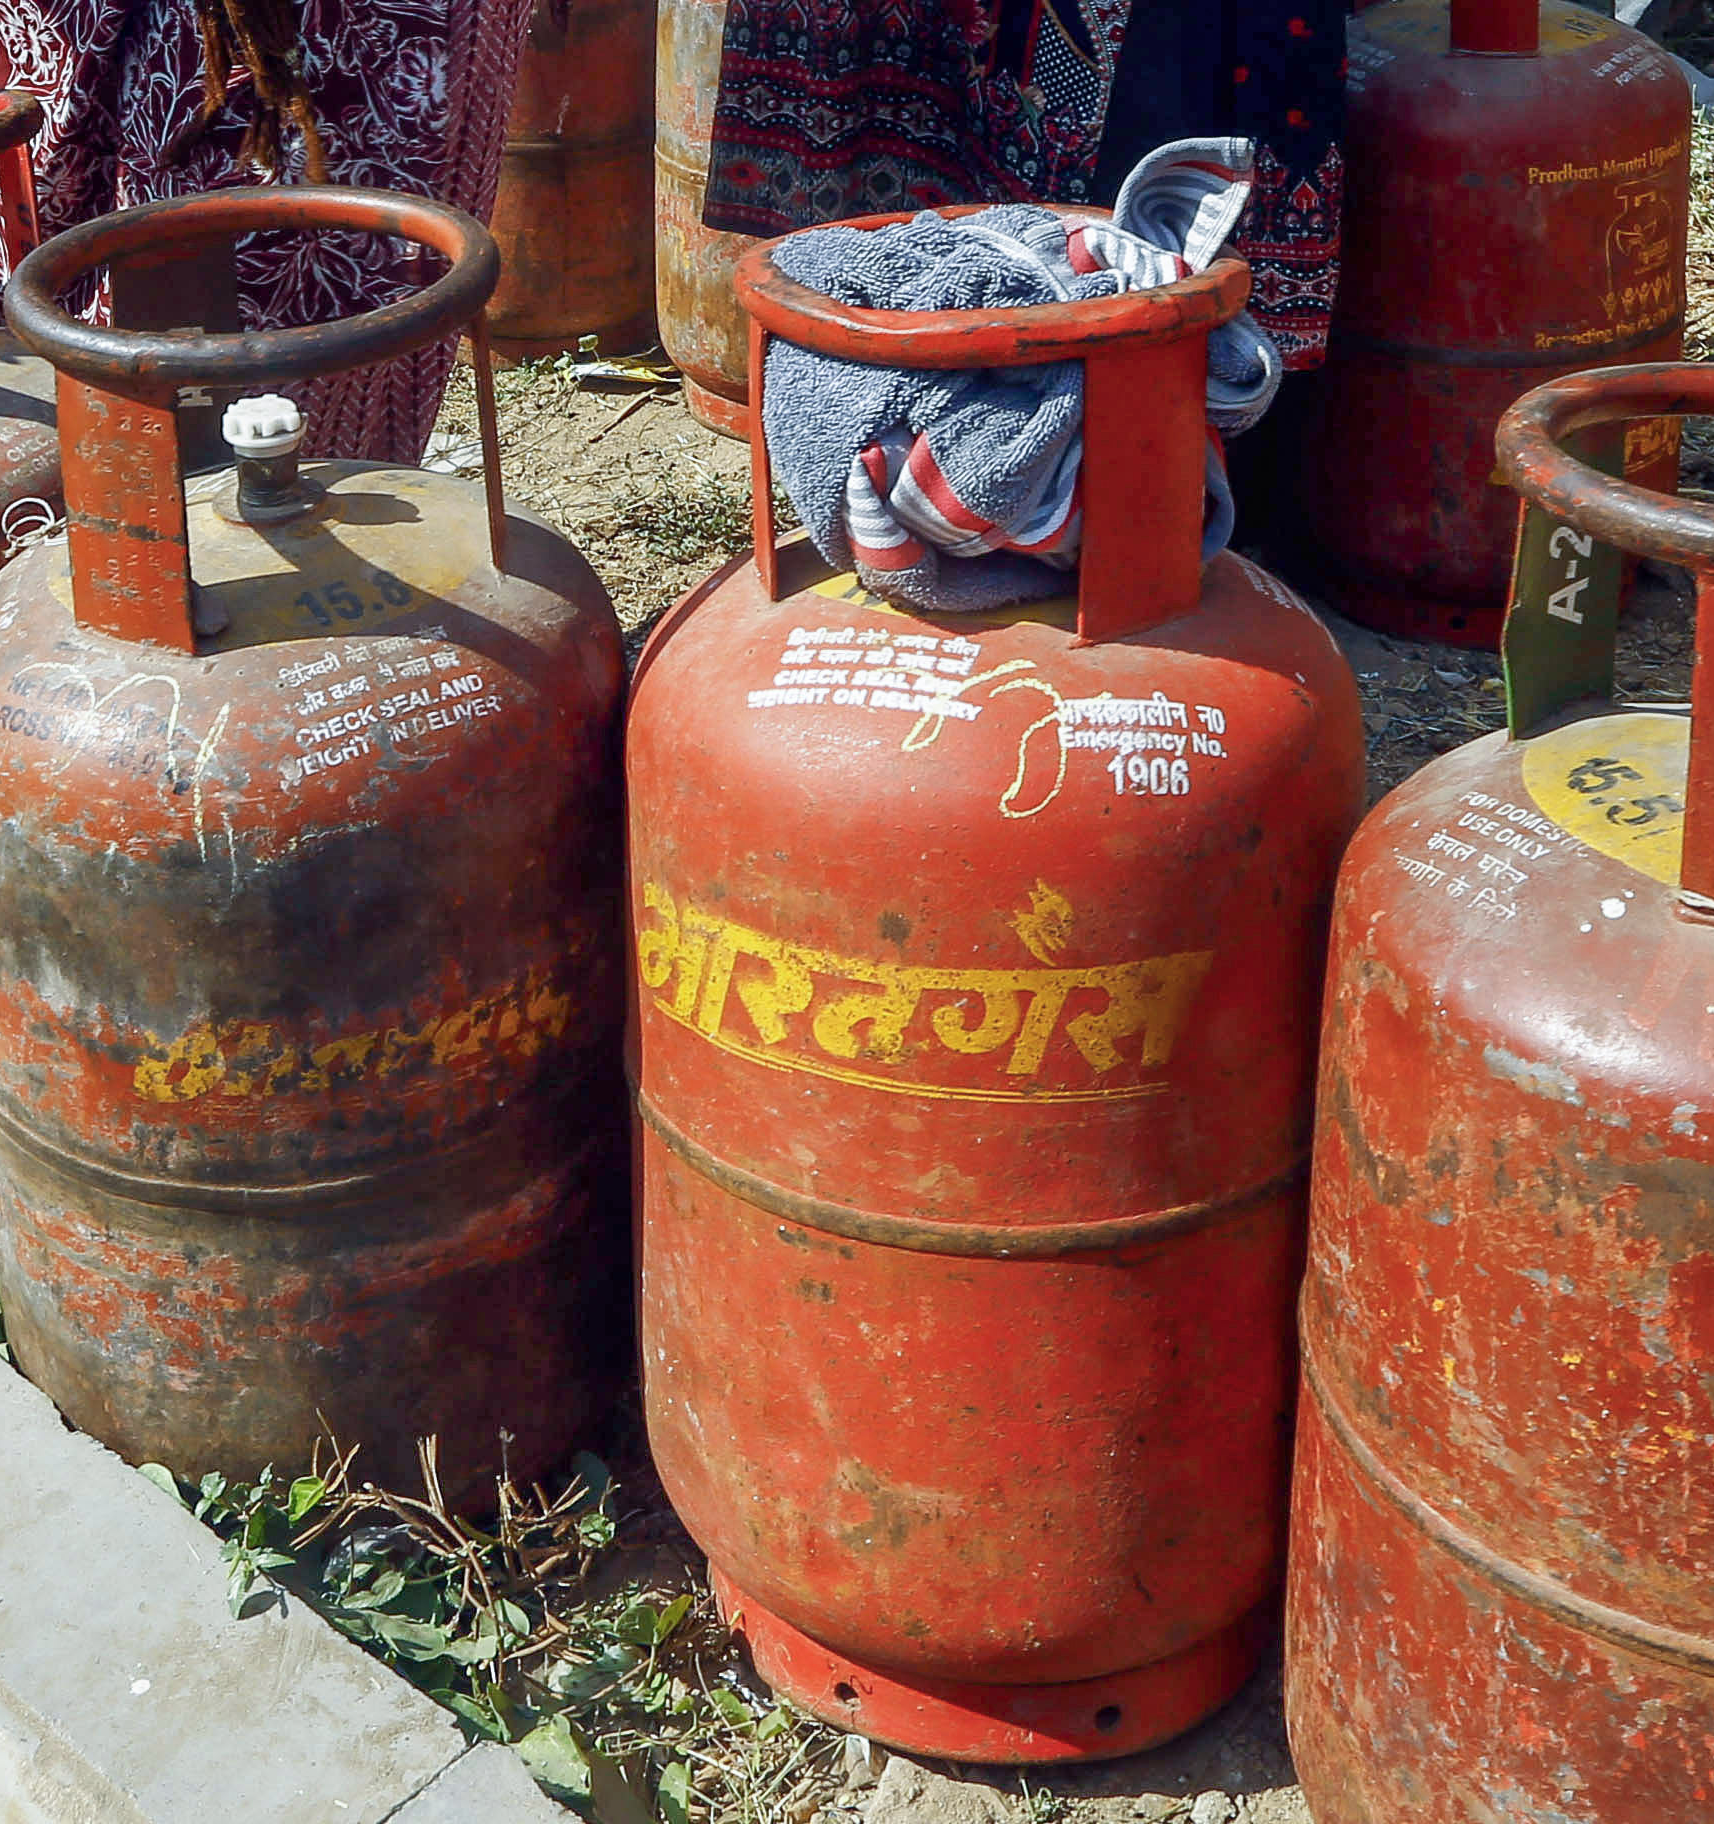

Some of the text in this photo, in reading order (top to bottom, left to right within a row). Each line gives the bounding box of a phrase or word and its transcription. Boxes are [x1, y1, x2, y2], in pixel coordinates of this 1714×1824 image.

[1528, 162, 1599, 186] Pradhan
[1602, 152, 1648, 178] Mantri
[773, 669, 964, 697] CHECK SEAL AND
[294, 674, 484, 748] CHECK SEAL AND
[747, 688, 983, 722] WEIGHT ON DELIVERY
[1057, 726, 1228, 759] Emergency No.
[1106, 754, 1191, 796] 1906
[1459, 790, 1498, 811] FOR
[1457, 811, 1552, 861] USE ONLY
